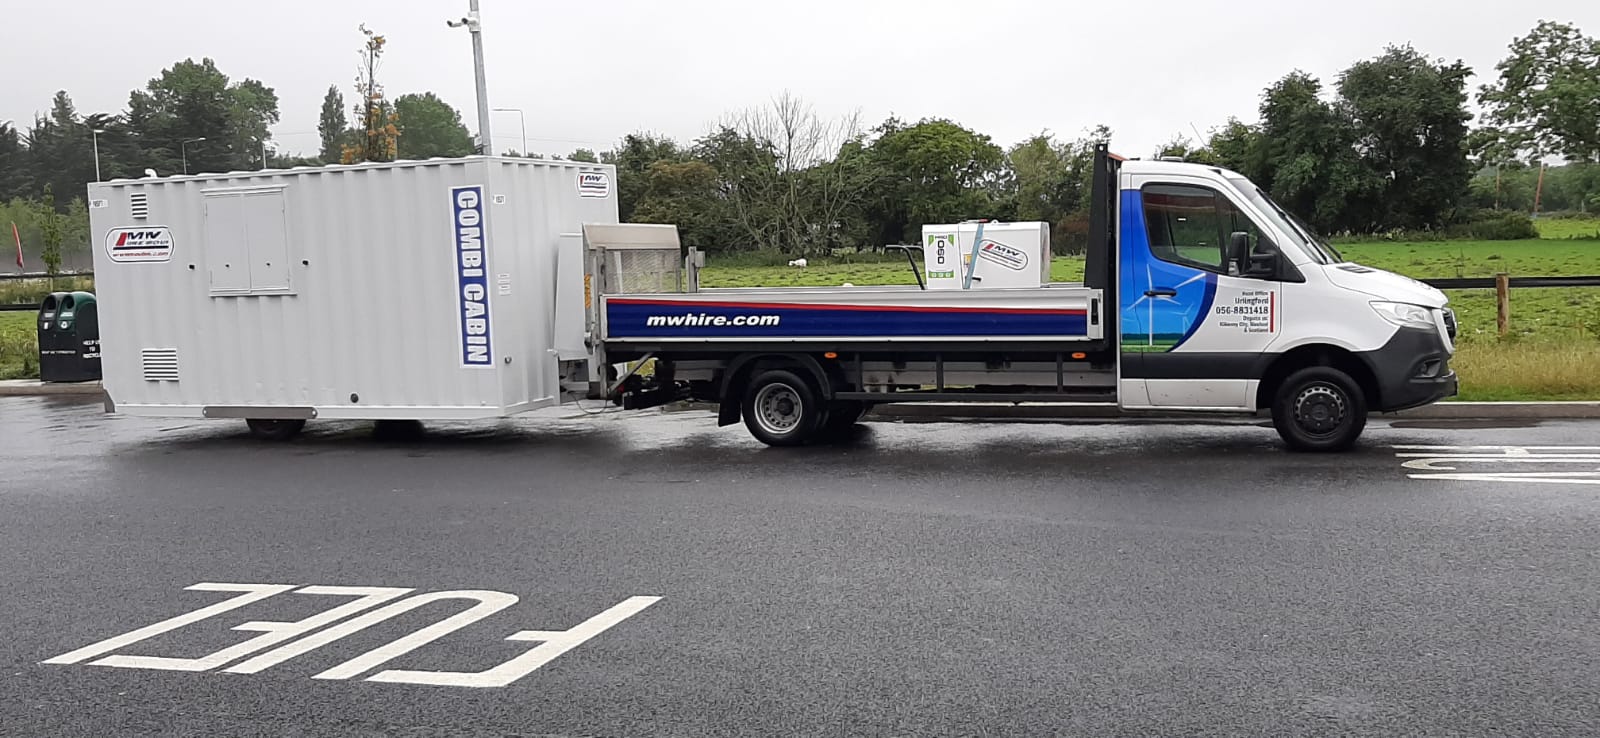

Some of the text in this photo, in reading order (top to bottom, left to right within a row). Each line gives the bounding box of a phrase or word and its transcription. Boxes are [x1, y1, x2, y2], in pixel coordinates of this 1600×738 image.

[457, 190, 488, 362] COMBI CABIN
[1235, 298, 1268, 306] Urlingford
[1216, 306, 1269, 314] 056-8831418
[646, 313, 780, 327] mwhire.com
[41, 582, 663, 688] FUEL
